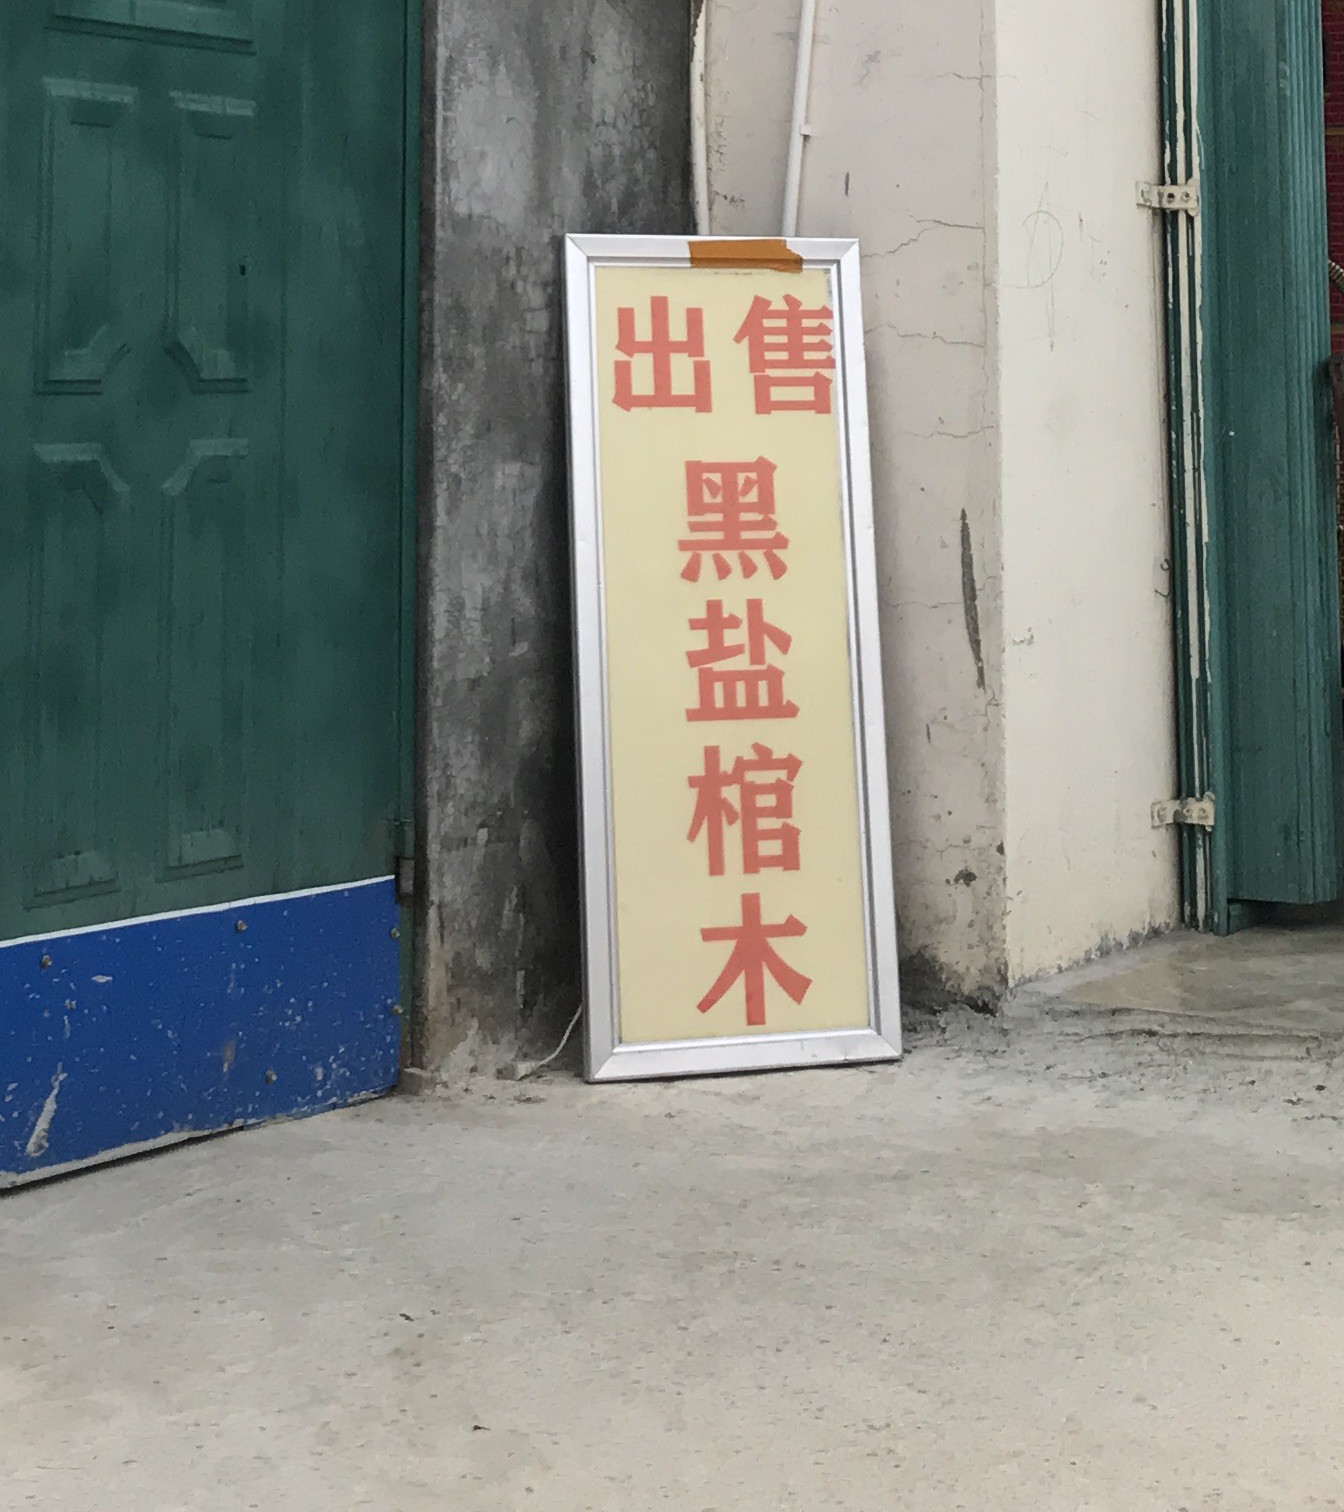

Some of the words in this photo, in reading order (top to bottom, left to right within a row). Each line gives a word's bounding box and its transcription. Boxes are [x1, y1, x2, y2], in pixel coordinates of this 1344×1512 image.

[612, 294, 836, 415] 出售
[678, 455, 813, 1026] 黑盐棺木
